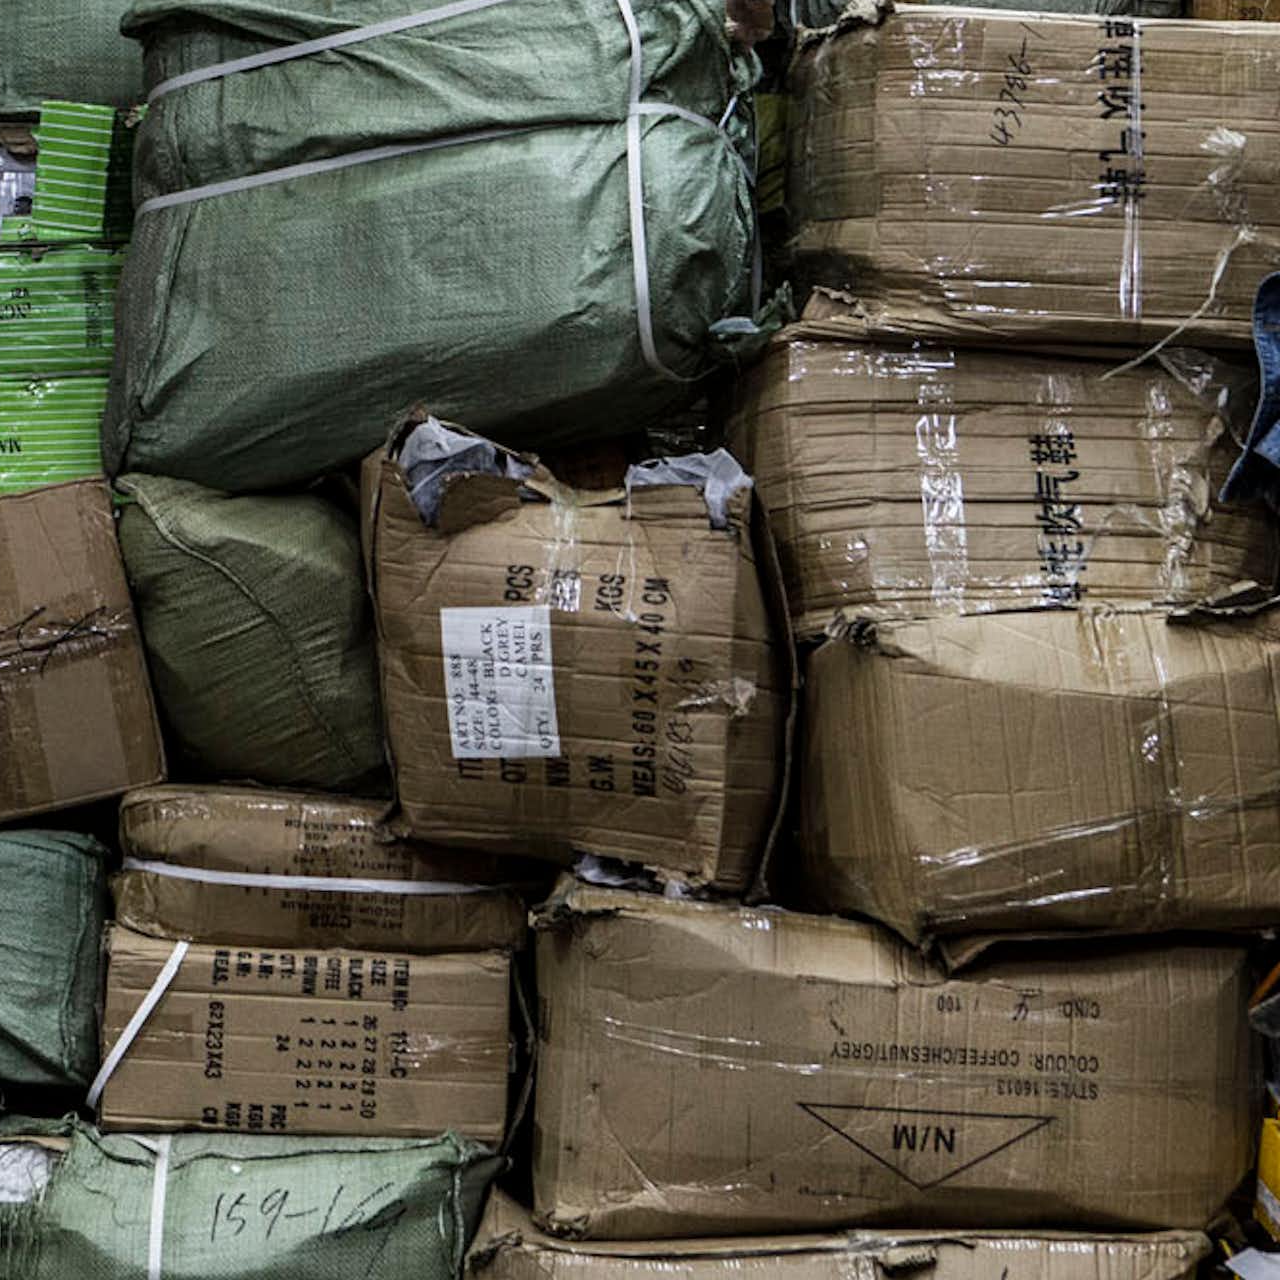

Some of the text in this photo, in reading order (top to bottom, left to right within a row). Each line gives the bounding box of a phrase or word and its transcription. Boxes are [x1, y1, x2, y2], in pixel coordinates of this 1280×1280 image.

[503, 563, 534, 602] PCS
[593, 572, 625, 613] KGS
[512, 620, 528, 678] CAMEL
[479, 622, 502, 751] COLOR: BLACK
[529, 631, 554, 751] QTY: 24 PRS
[631, 577, 670, 798] MEAS: 60 X 45 X 40 CM
[455, 719, 470, 751] ART
[472, 709, 487, 751] SIZE:
[347, 958, 364, 1000] BLACK
[370, 959, 387, 987] SIZE
[936, 994, 962, 1012] 100
[203, 1001, 226, 1080] 62X23X43
[275, 1034, 291, 1052] 24
[298, 1039, 314, 1048] 2
[320, 1040, 336, 1049] 2
[340, 1040, 357, 1049] 2
[363, 1036, 378, 1053] 27
[295, 1059, 312, 1069] 2
[318, 1060, 333, 1069] 2
[339, 1062, 356, 1071] 2
[361, 1058, 376, 1075] 28
[828, 1040, 1101, 1074] COLOUR: COFFEE/CHESNUT/GREY
[295, 1080, 311, 1089] 2
[317, 1080, 333, 1089] 2
[339, 1082, 356, 1091] 2
[1043, 1080, 1099, 1101] STYLE:
[201, 1107, 220, 1125] CM
[359, 1100, 376, 1120] 30
[891, 1122, 956, 1154] N/M
